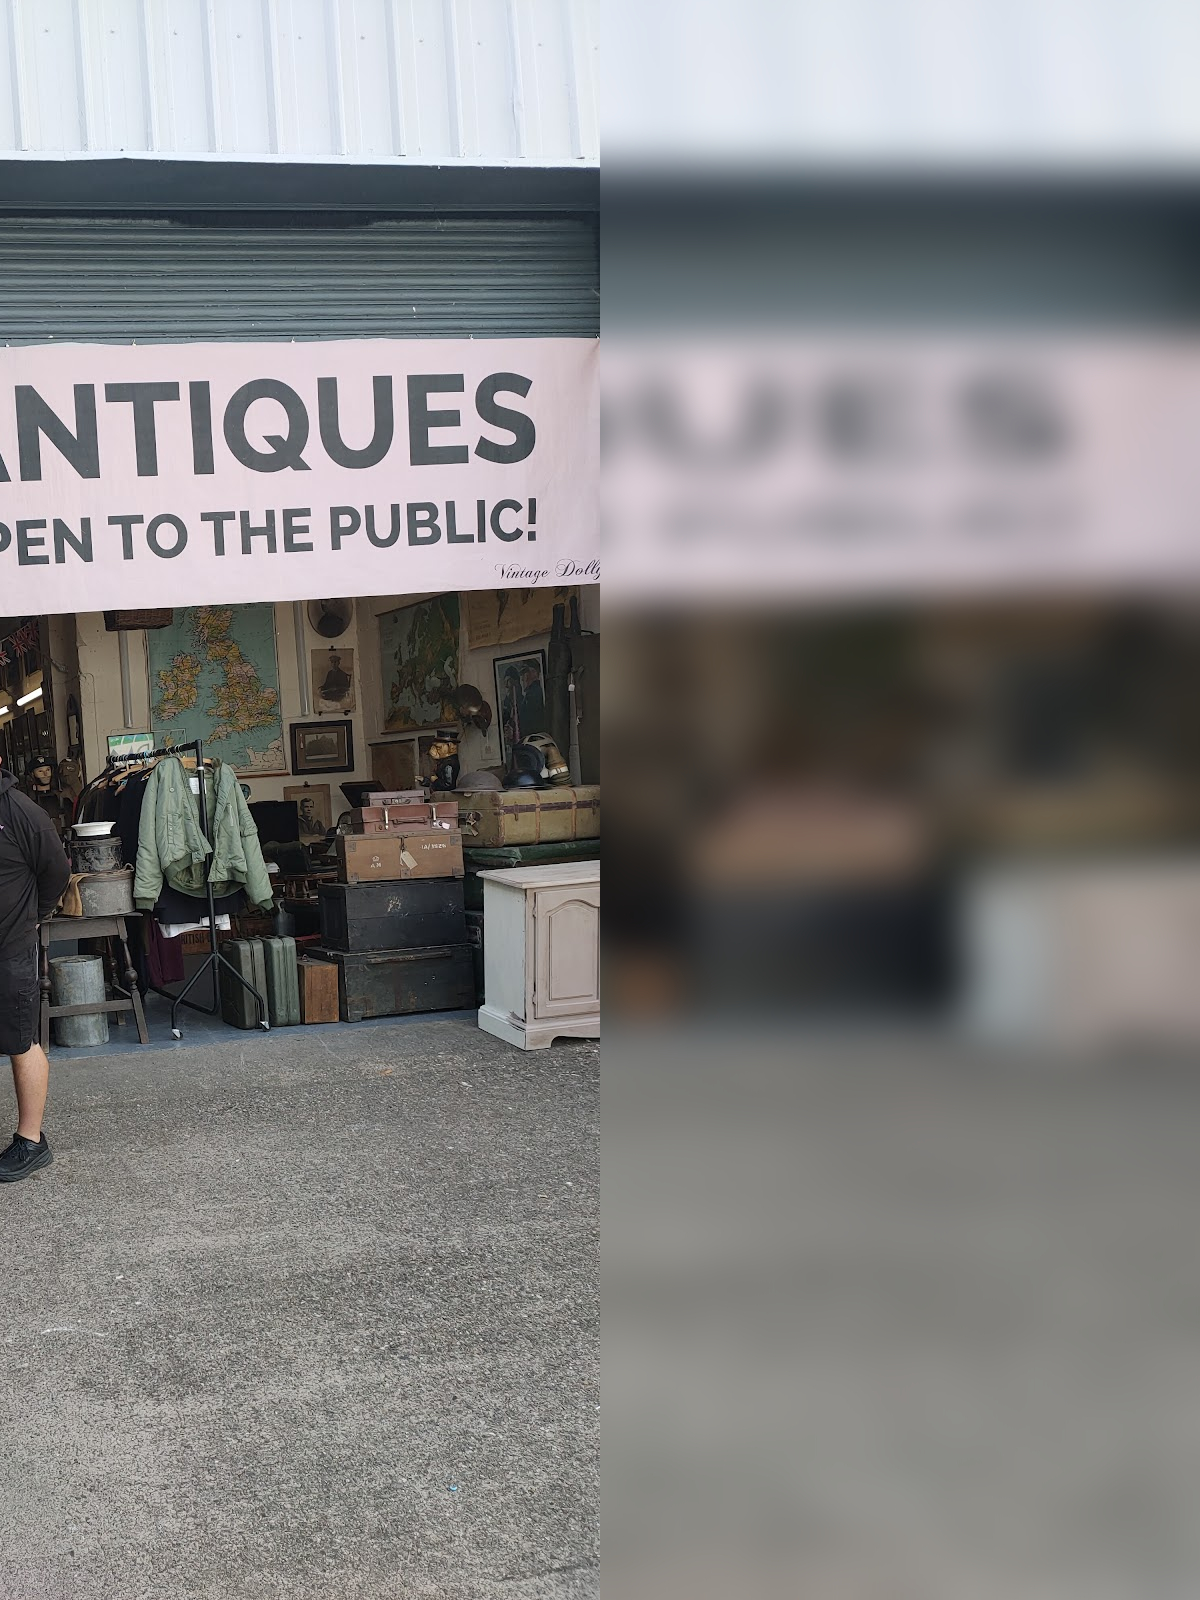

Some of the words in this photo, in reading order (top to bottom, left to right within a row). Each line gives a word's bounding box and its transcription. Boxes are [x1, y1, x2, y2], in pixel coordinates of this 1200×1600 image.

[108, 513, 188, 560] TO
[201, 508, 313, 557] THE
[330, 497, 538, 551] PUBLIC!
[494, 563, 551, 585] Vintage
[554, 558, 600, 581] Dolly
